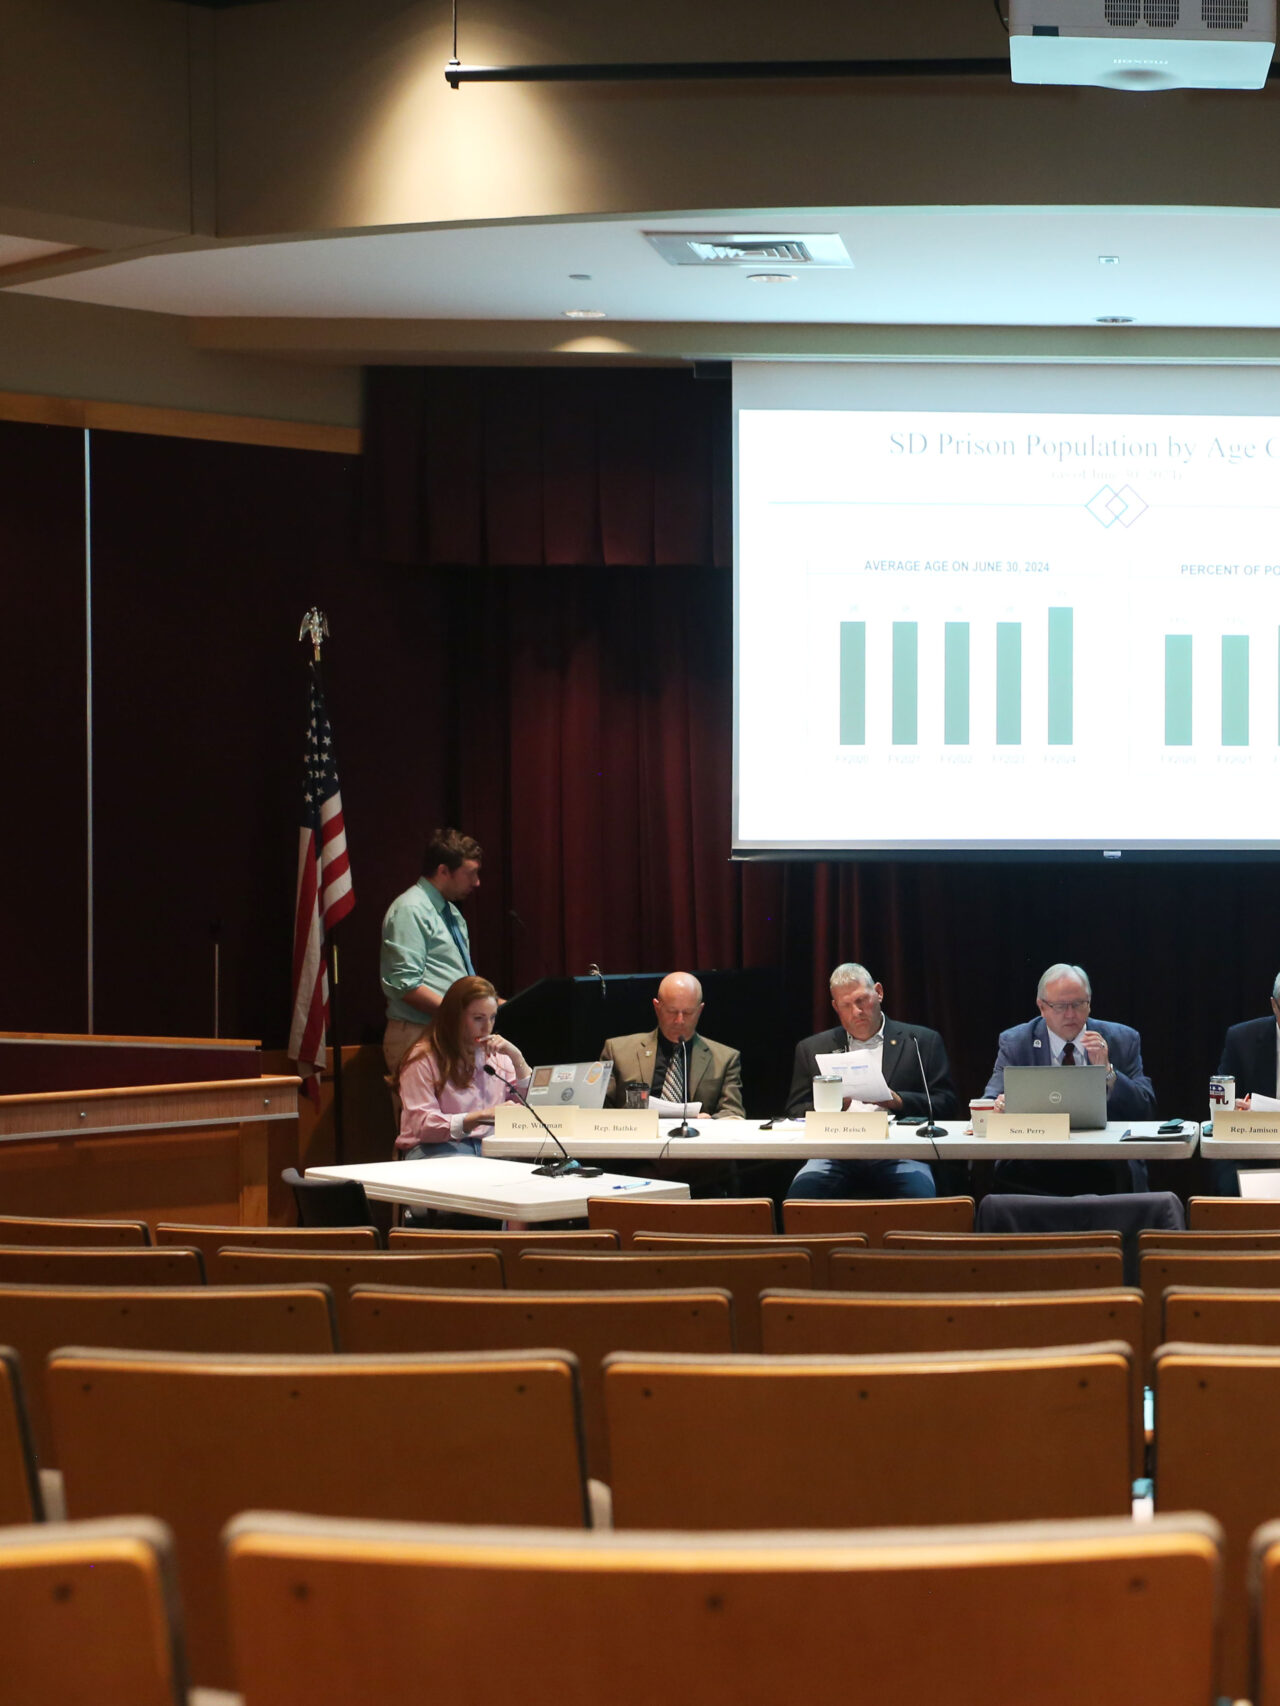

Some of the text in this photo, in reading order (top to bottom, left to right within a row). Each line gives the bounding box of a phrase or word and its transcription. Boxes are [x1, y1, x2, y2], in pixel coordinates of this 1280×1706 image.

[889, 431, 928, 455] SD
[939, 431, 1016, 457] Prison
[1026, 433, 1158, 463] Population
[1168, 434, 1195, 465] by
[1207, 436, 1257, 466] Age
[864, 559, 921, 572] AVERAGE
[924, 560, 948, 572] AGE
[951, 560, 969, 572] ON
[973, 561, 1002, 572] JUNE
[1024, 561, 1050, 573] 2024
[1180, 564, 1239, 576] PERCENT
[1243, 564, 1260, 576] OF
[511, 1122, 529, 1131] Rep.
[594, 1124, 610, 1133] Rep.
[824, 1126, 841, 1134] Rep.
[1230, 1126, 1279, 1136] Rep. Jamison
